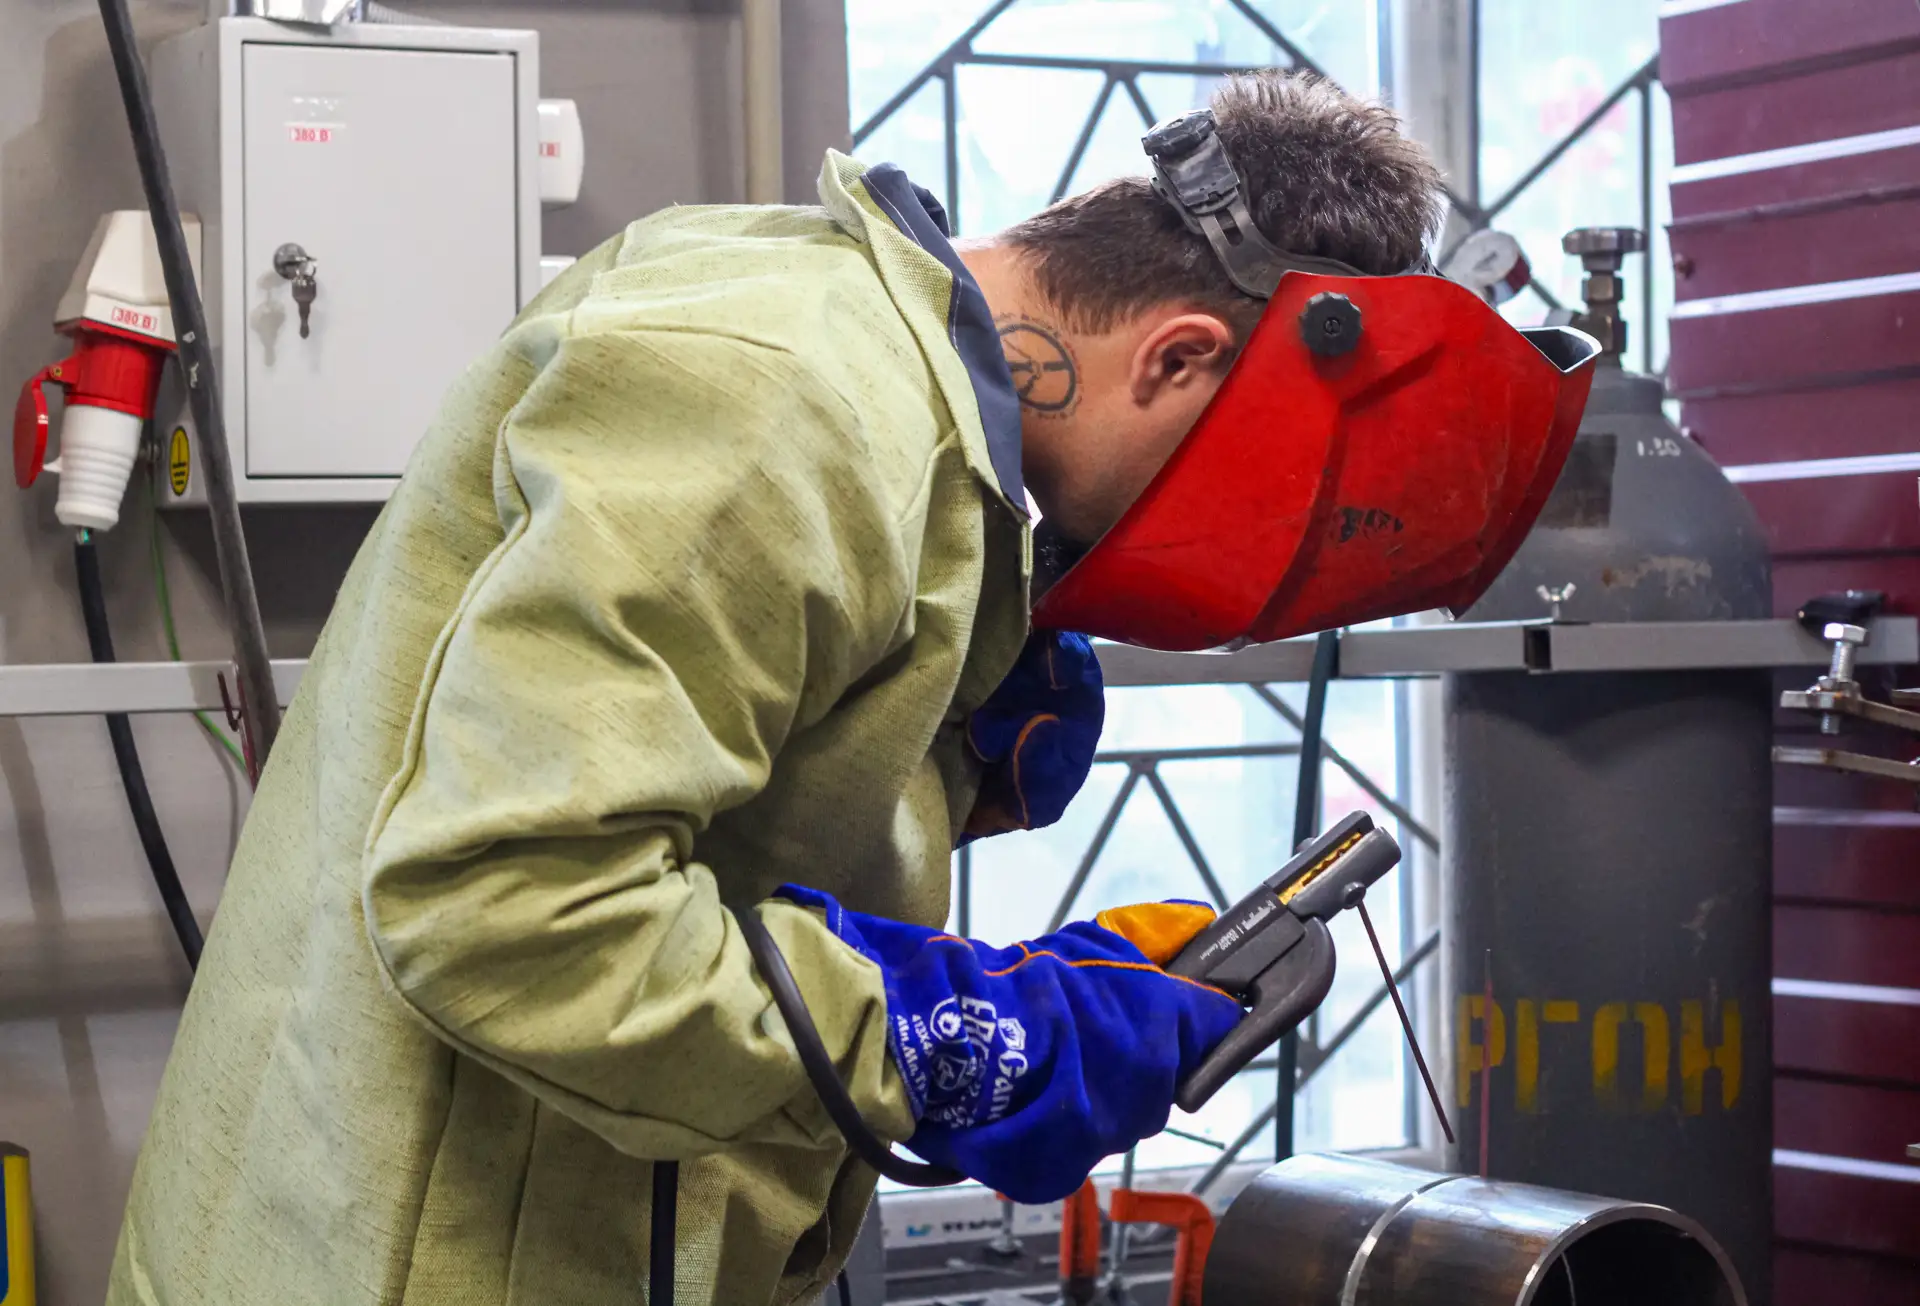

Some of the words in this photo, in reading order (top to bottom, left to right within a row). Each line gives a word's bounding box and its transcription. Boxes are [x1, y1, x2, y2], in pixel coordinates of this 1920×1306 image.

[294, 127, 316, 142] 380
[116, 308, 139, 326] 380
[1458, 995, 1742, 1115] РГОН
